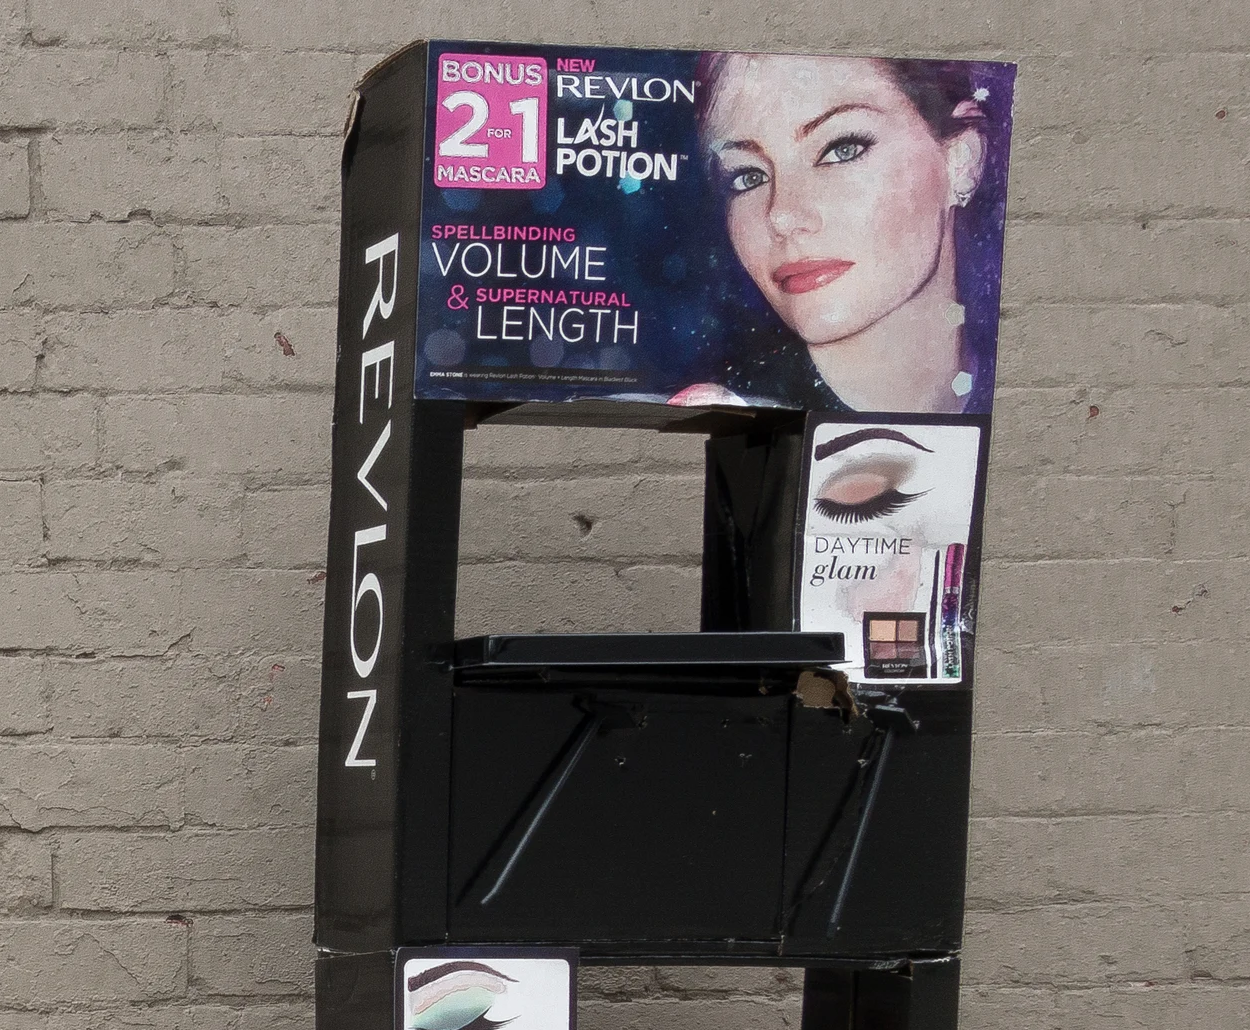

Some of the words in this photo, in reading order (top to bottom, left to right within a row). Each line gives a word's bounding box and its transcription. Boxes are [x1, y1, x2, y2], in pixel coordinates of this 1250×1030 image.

[441, 60, 544, 87] BONUS
[556, 58, 596, 73] NEW
[438, 90, 490, 159] 2
[486, 128, 512, 139] FOR
[509, 97, 539, 164] 1
[557, 104, 639, 148] LASH
[436, 166, 541, 184] MASCARA
[431, 225, 576, 242] SPELLBINDING
[432, 242, 608, 281] VOLUME
[446, 284, 470, 310] &
[476, 287, 631, 307] SUPERNATURAL
[477, 306, 639, 345] LENGTH
[814, 536, 913, 556] DAYTIME
[810, 555, 878, 587] glam
